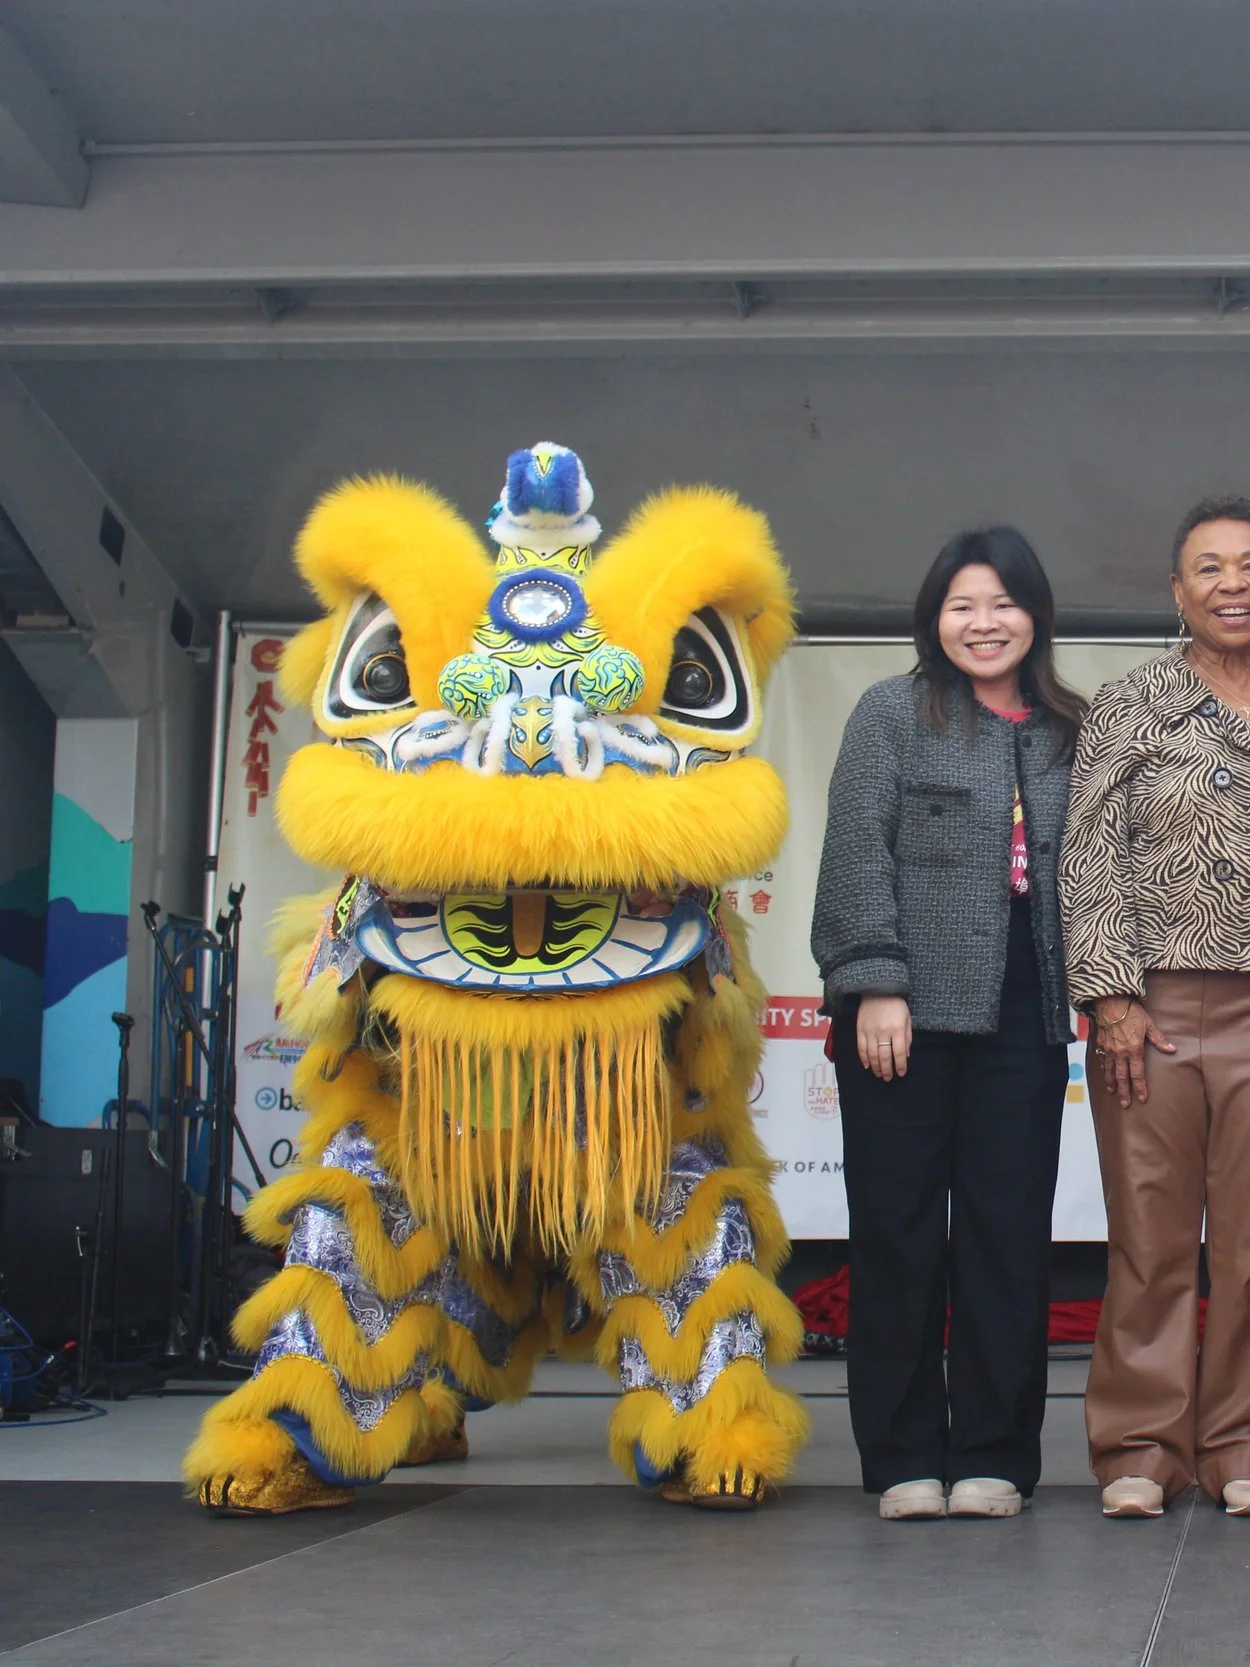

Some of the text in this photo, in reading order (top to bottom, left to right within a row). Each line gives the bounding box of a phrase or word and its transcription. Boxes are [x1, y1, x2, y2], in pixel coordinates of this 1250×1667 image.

[756, 1008, 795, 1026] ITY
[816, 1097, 839, 1106] HATE
[794, 1161, 815, 1174] OF
